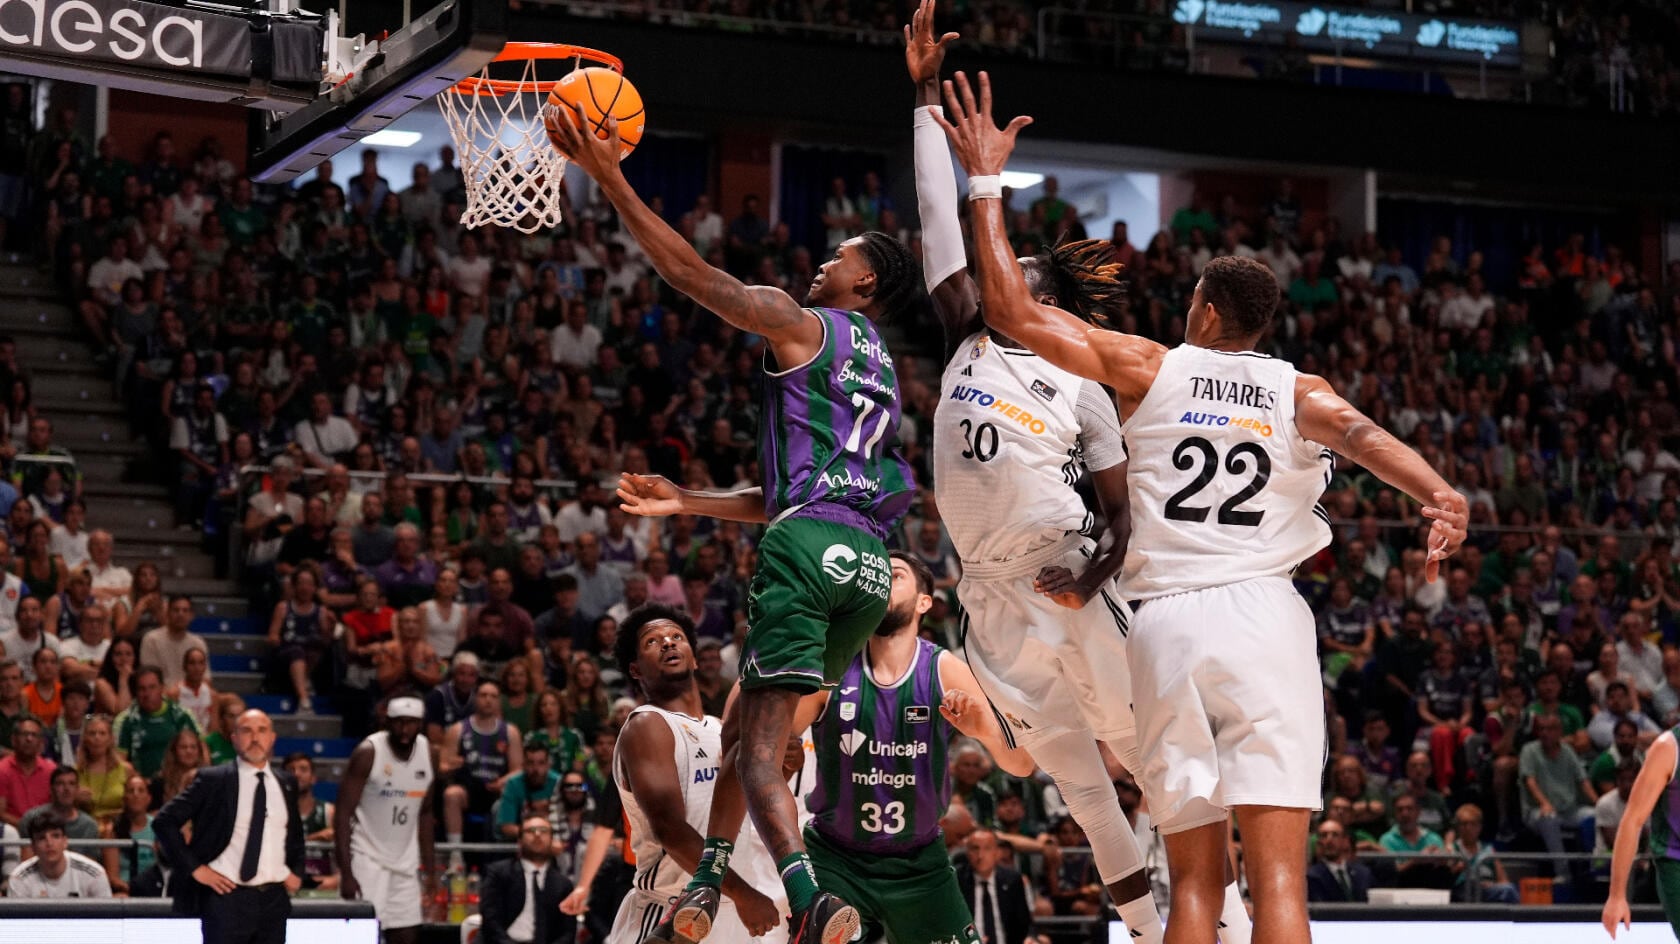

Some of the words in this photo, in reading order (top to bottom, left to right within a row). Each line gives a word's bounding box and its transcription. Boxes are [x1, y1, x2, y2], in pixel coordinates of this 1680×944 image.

[850, 324, 893, 370] Carte
[1189, 376, 1277, 410] TAVARES
[950, 385, 1046, 435] AUTOHERO
[1179, 411, 1273, 438] AUTOHERO
[959, 418, 999, 463] 30
[1164, 436, 1272, 527] 22
[860, 566, 878, 583] DEL
[861, 551, 892, 577] COSTA
[868, 740, 928, 760] Unicaja
[392, 805, 409, 826] 16
[861, 801, 906, 834] 33
